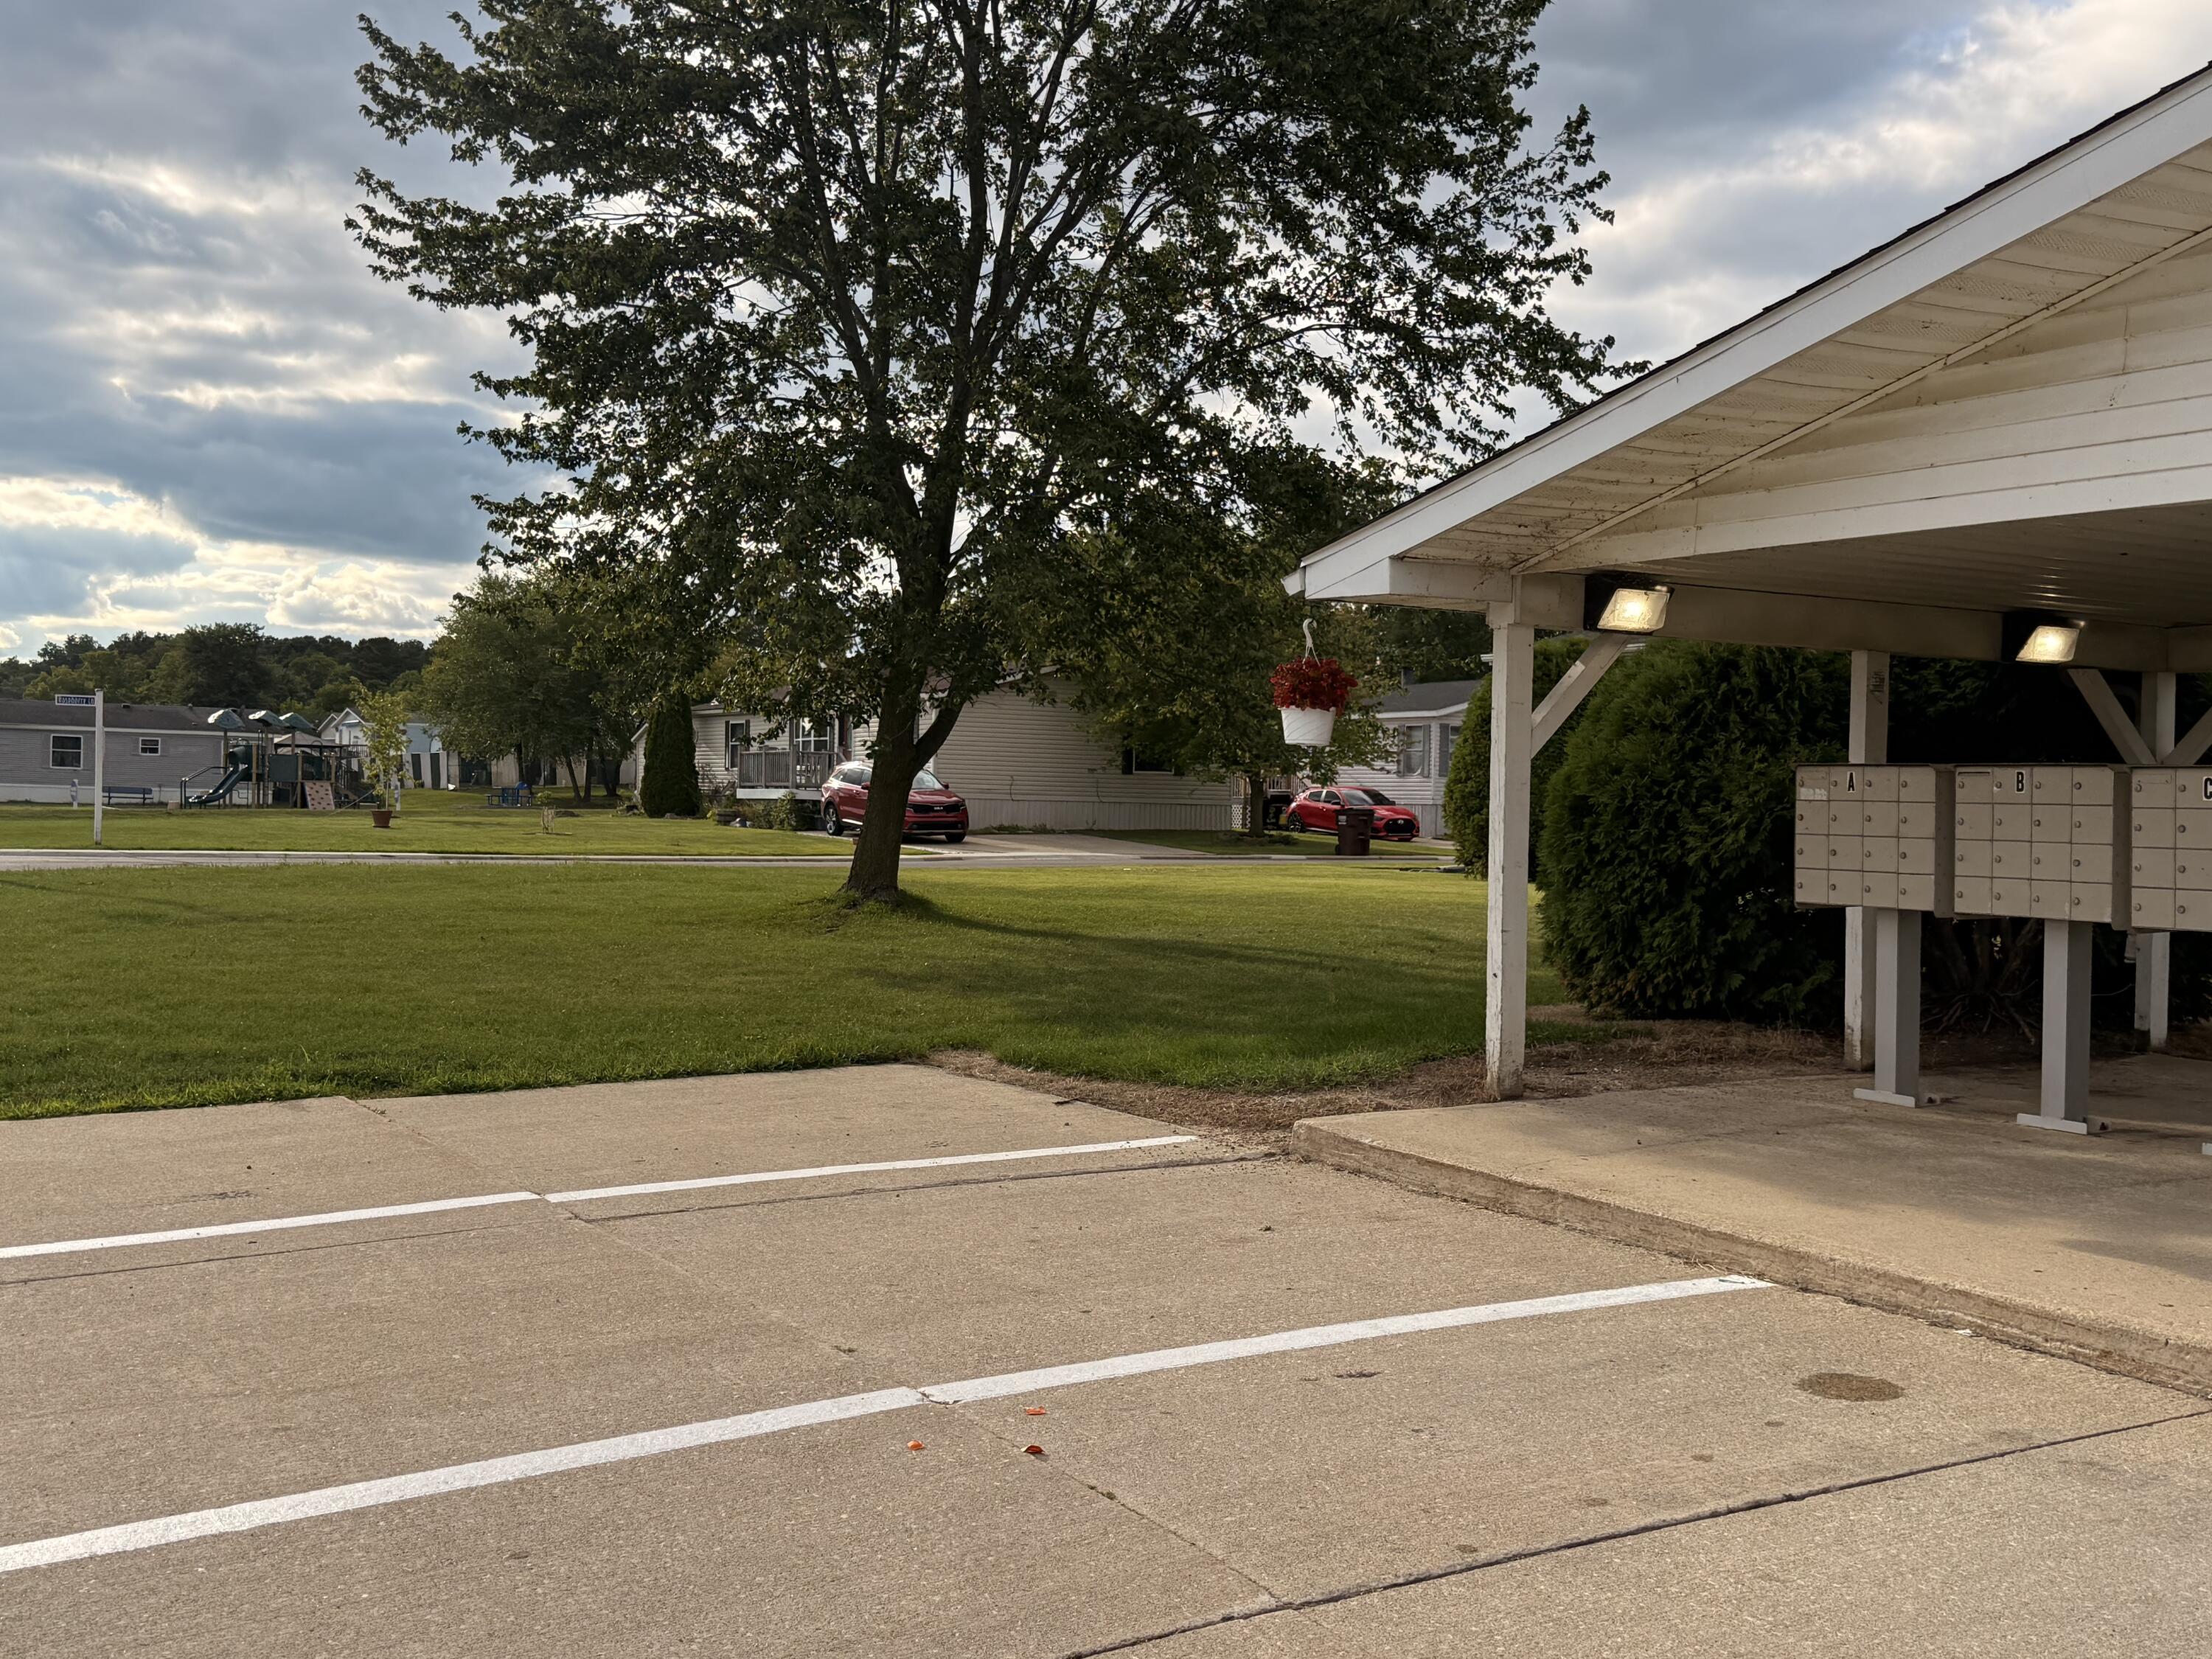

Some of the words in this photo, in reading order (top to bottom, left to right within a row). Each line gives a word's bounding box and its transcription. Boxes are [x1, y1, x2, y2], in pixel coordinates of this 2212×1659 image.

[1847, 772, 1855, 792] A
[2016, 771, 2024, 793] B
[2204, 777, 2212, 800] C
